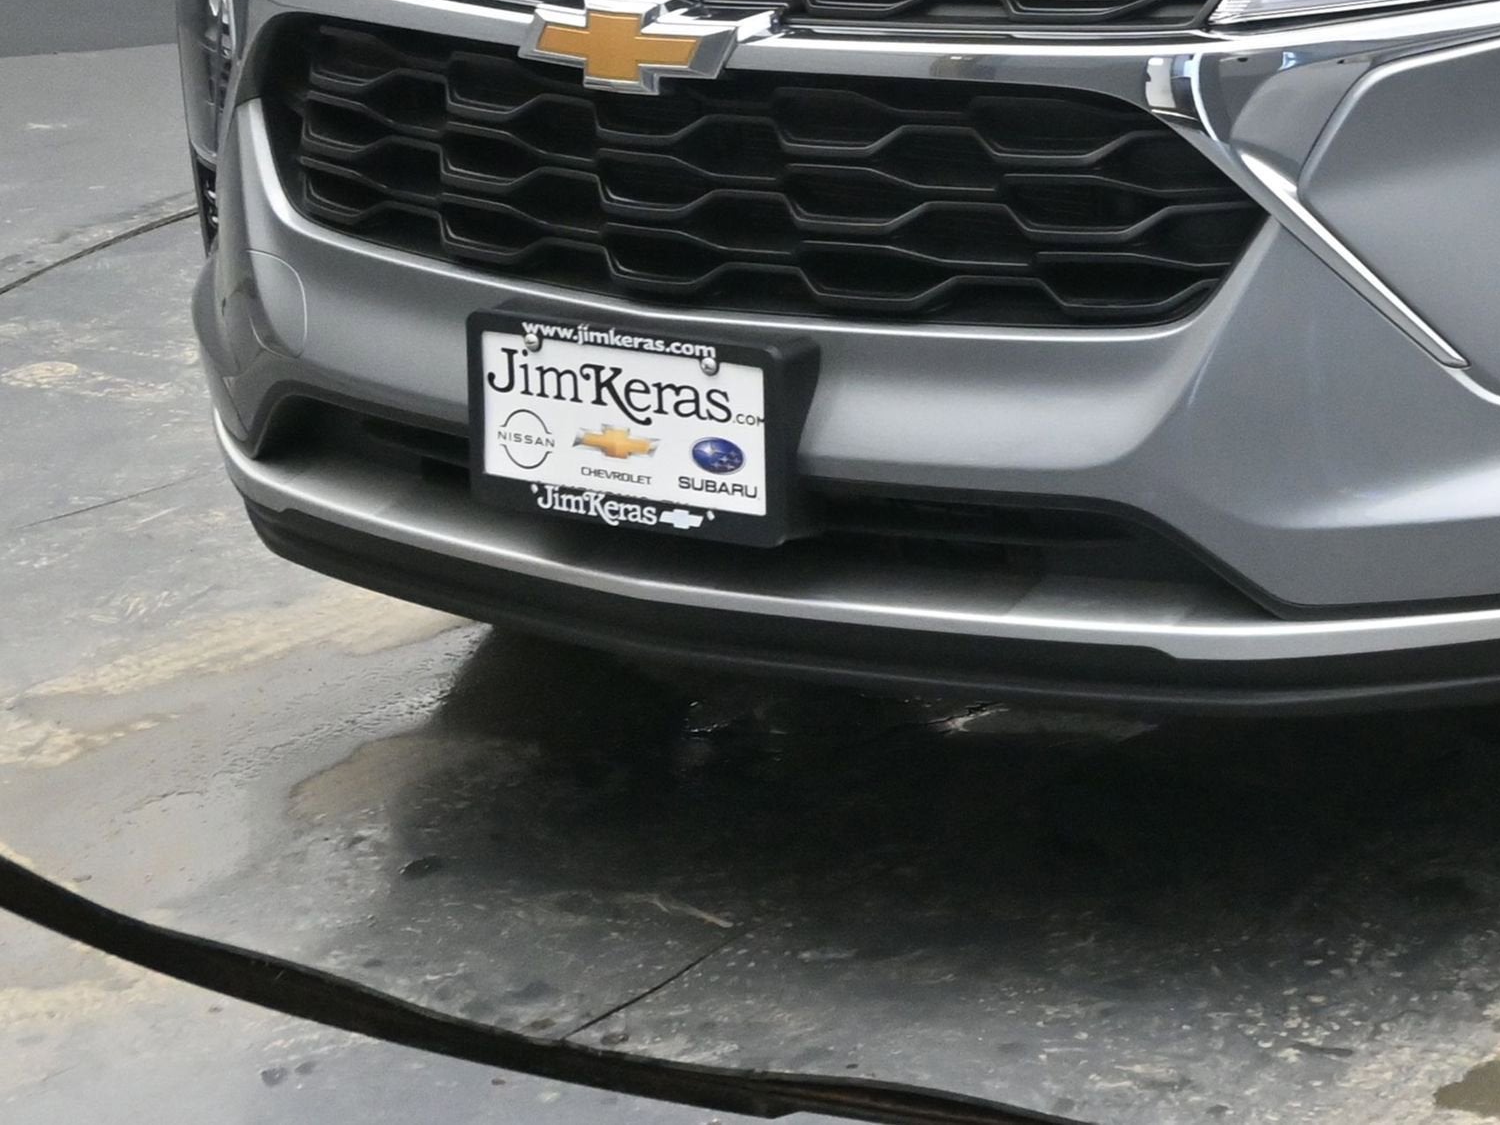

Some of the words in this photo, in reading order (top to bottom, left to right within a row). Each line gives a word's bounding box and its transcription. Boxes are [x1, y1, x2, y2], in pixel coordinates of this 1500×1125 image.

[522, 321, 717, 358] www.jimkeras.com
[497, 430, 555, 448] NISSAN
[580, 466, 652, 485] CHEVROLET
[678, 476, 758, 499] SUBARU
